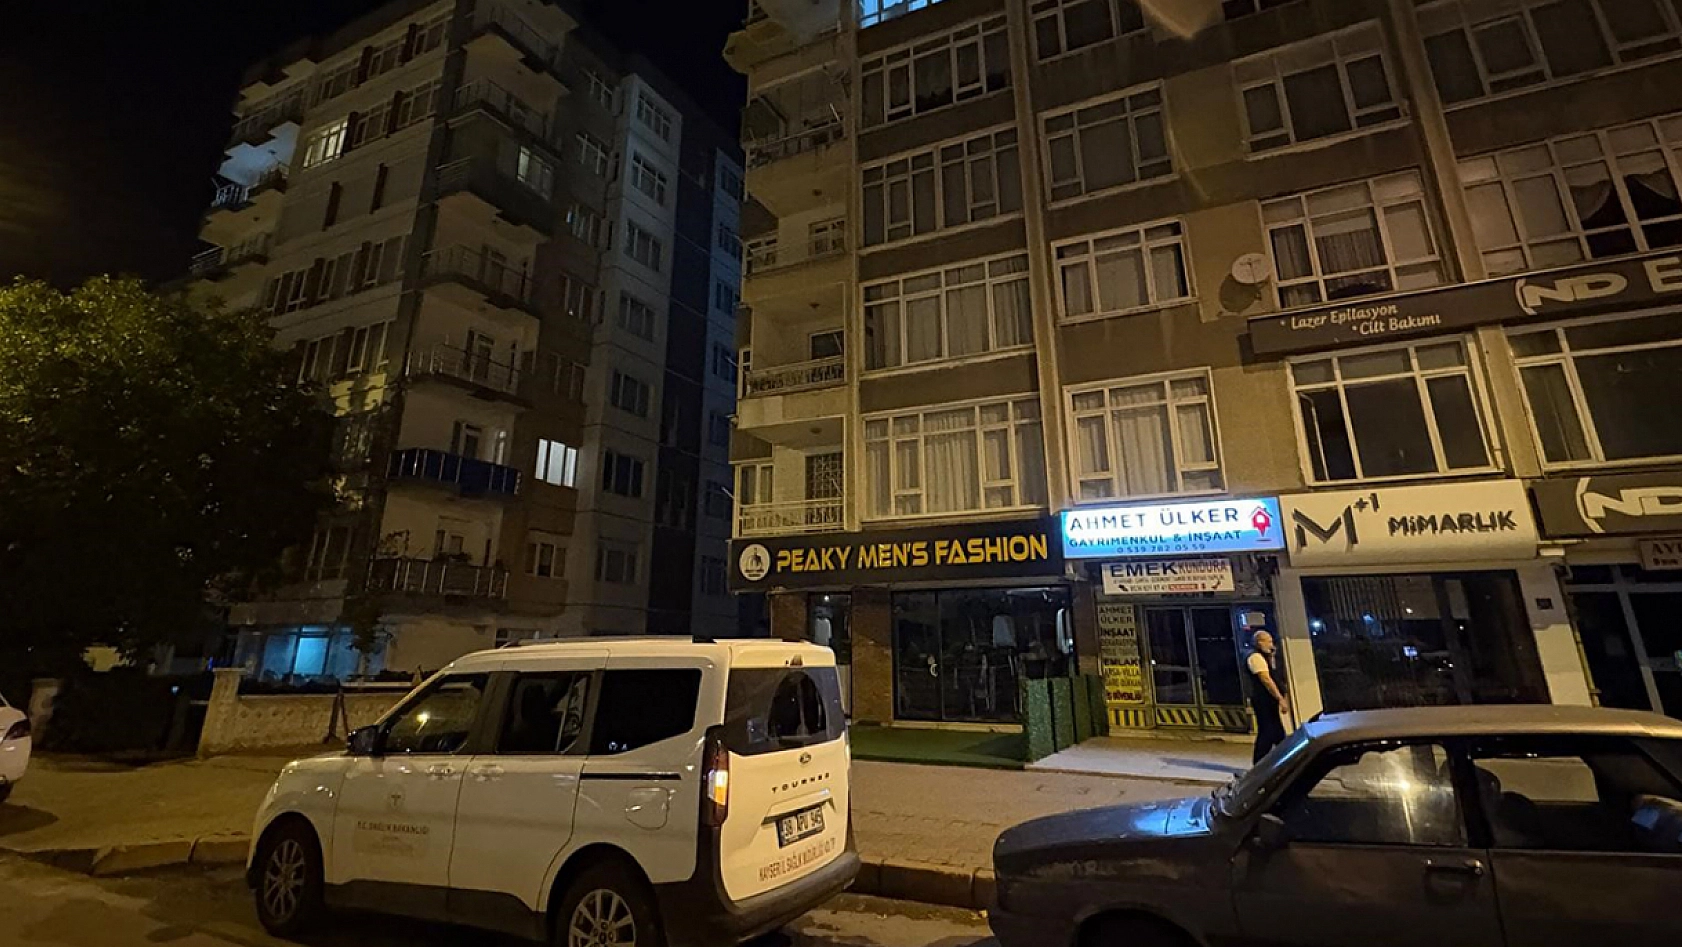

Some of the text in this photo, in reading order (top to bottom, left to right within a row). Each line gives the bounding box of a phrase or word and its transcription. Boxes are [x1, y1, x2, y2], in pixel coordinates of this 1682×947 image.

[1290, 315, 1327, 330] Lazer
[1359, 314, 1442, 335] Cilt Bakımı
[1070, 507, 1239, 531] AHMET ÜLKER
[1173, 533, 1181, 542] &
[777, 534, 1048, 573] PEAKY MEN'S FASHION
[1110, 560, 1226, 577] EMEK KUNDURA
